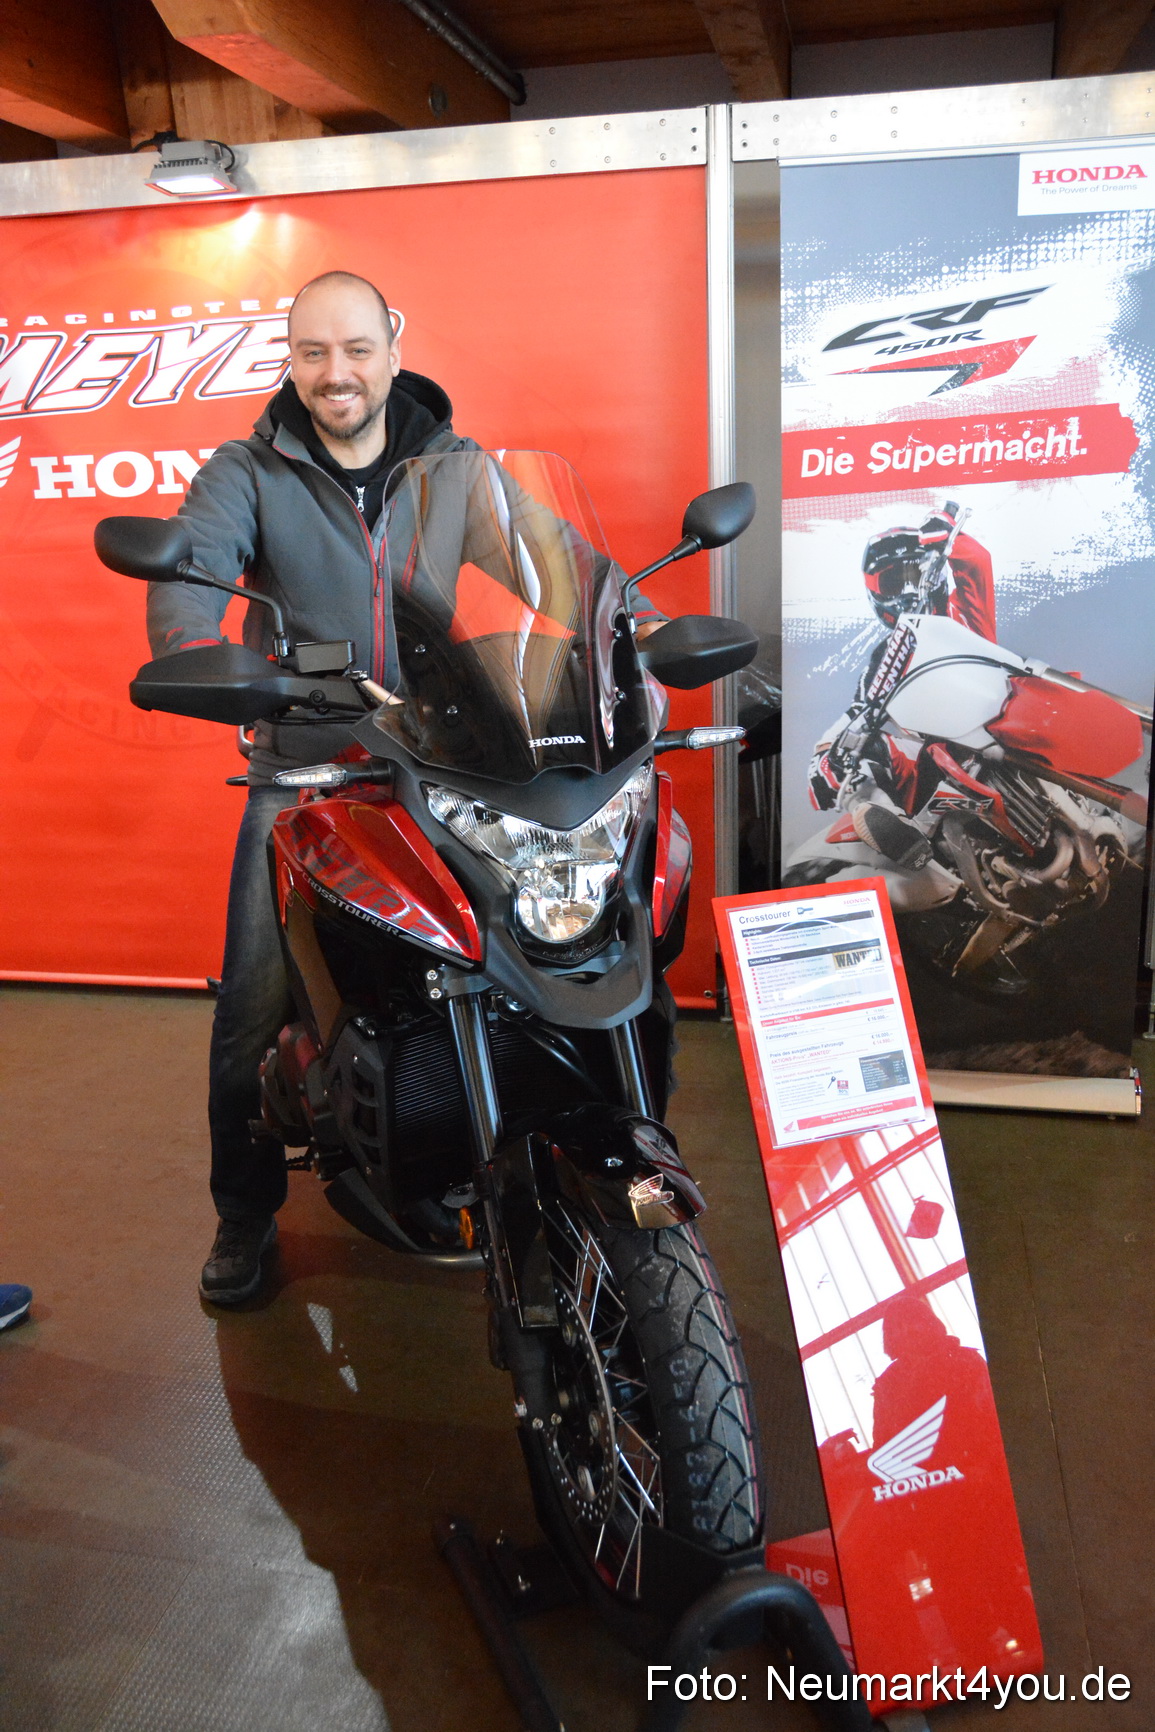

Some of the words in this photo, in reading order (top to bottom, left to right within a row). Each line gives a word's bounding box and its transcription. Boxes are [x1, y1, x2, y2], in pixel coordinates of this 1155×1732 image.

[1032, 164, 1147, 185] HONDA
[1040, 186, 1057, 195] The
[1059, 186, 1087, 195] Power
[1089, 184, 1099, 192] of
[1102, 183, 1138, 192] Dreams
[820, 282, 1058, 353] CRF
[874, 329, 985, 356] 450R
[0, 308, 405, 420] MEYE
[800, 448, 854, 478] Die
[528, 735, 586, 749] HONDA
[302, 873, 399, 936] CROSSTOURER
[738, 908, 791, 924] Crosstourer
[873, 1465, 964, 1502] HONDA
